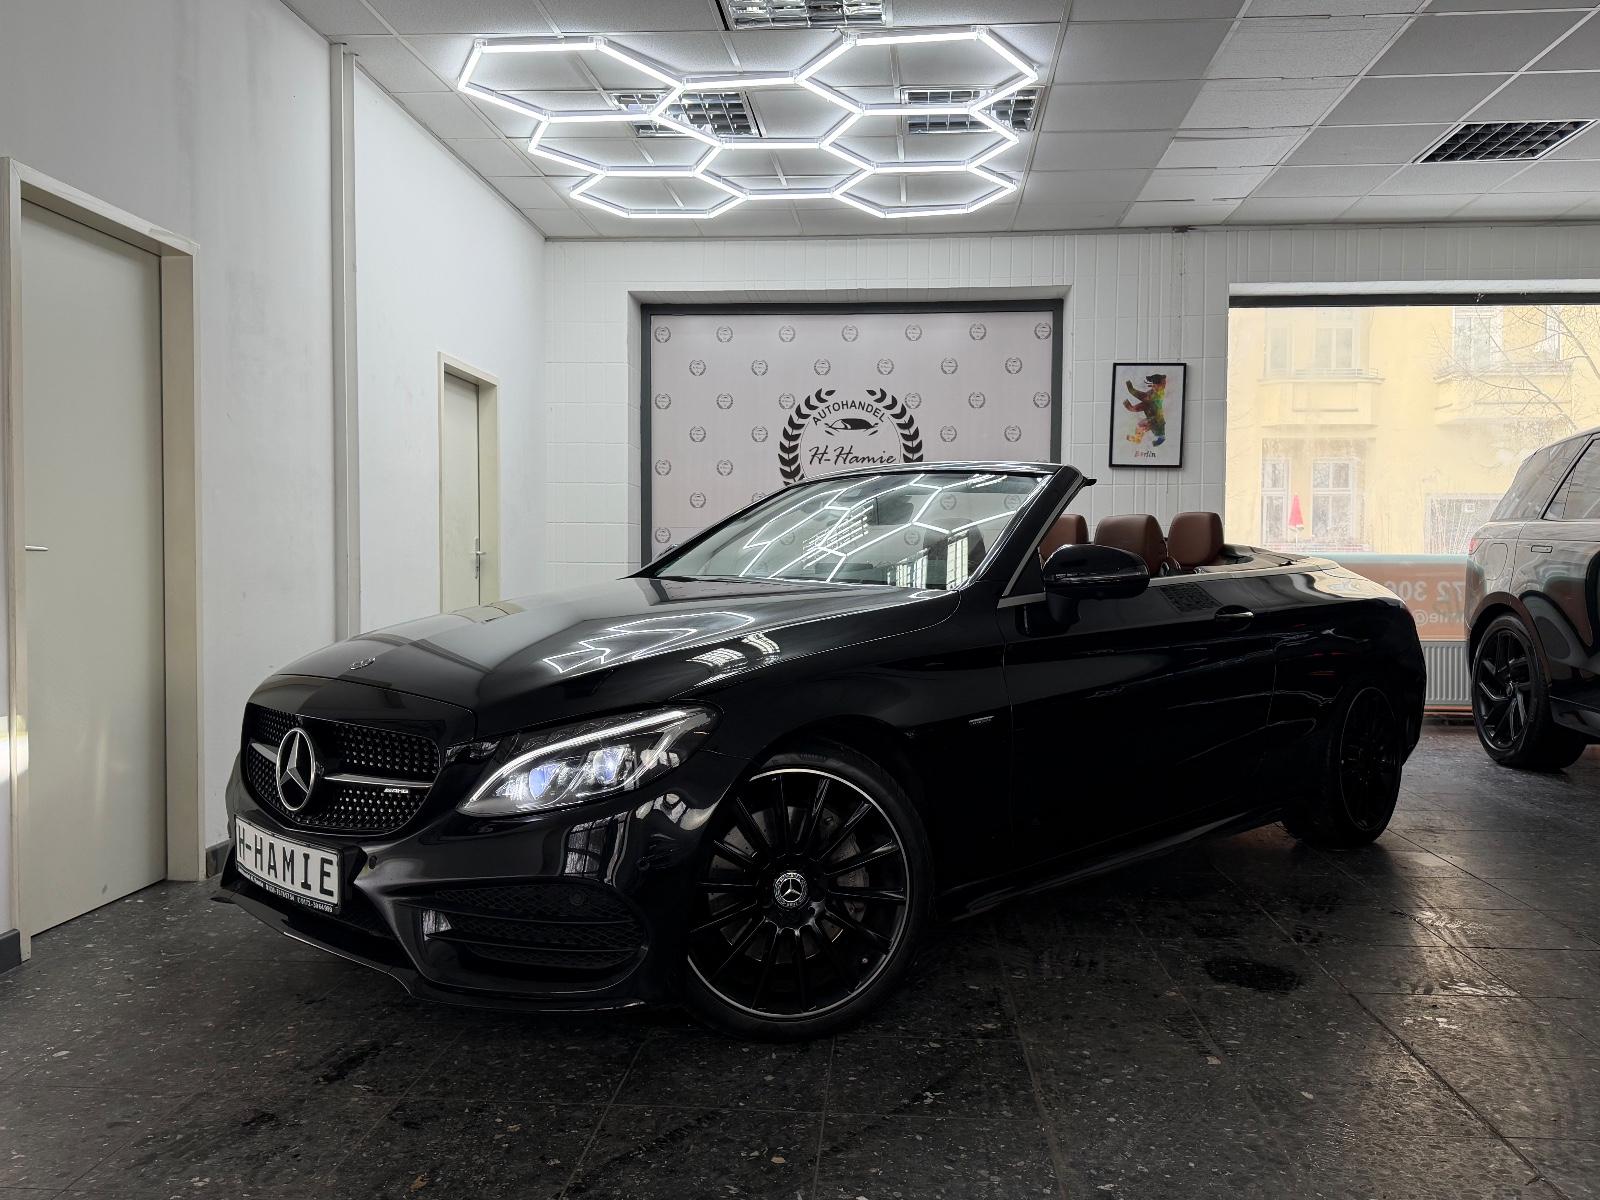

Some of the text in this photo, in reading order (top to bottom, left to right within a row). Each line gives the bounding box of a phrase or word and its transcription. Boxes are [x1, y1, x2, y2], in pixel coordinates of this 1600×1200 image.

[812, 399, 886, 426] AUTOHANDEL
[808, 444, 897, 466] H-Hamie
[238, 824, 334, 897] H-HAMIE
